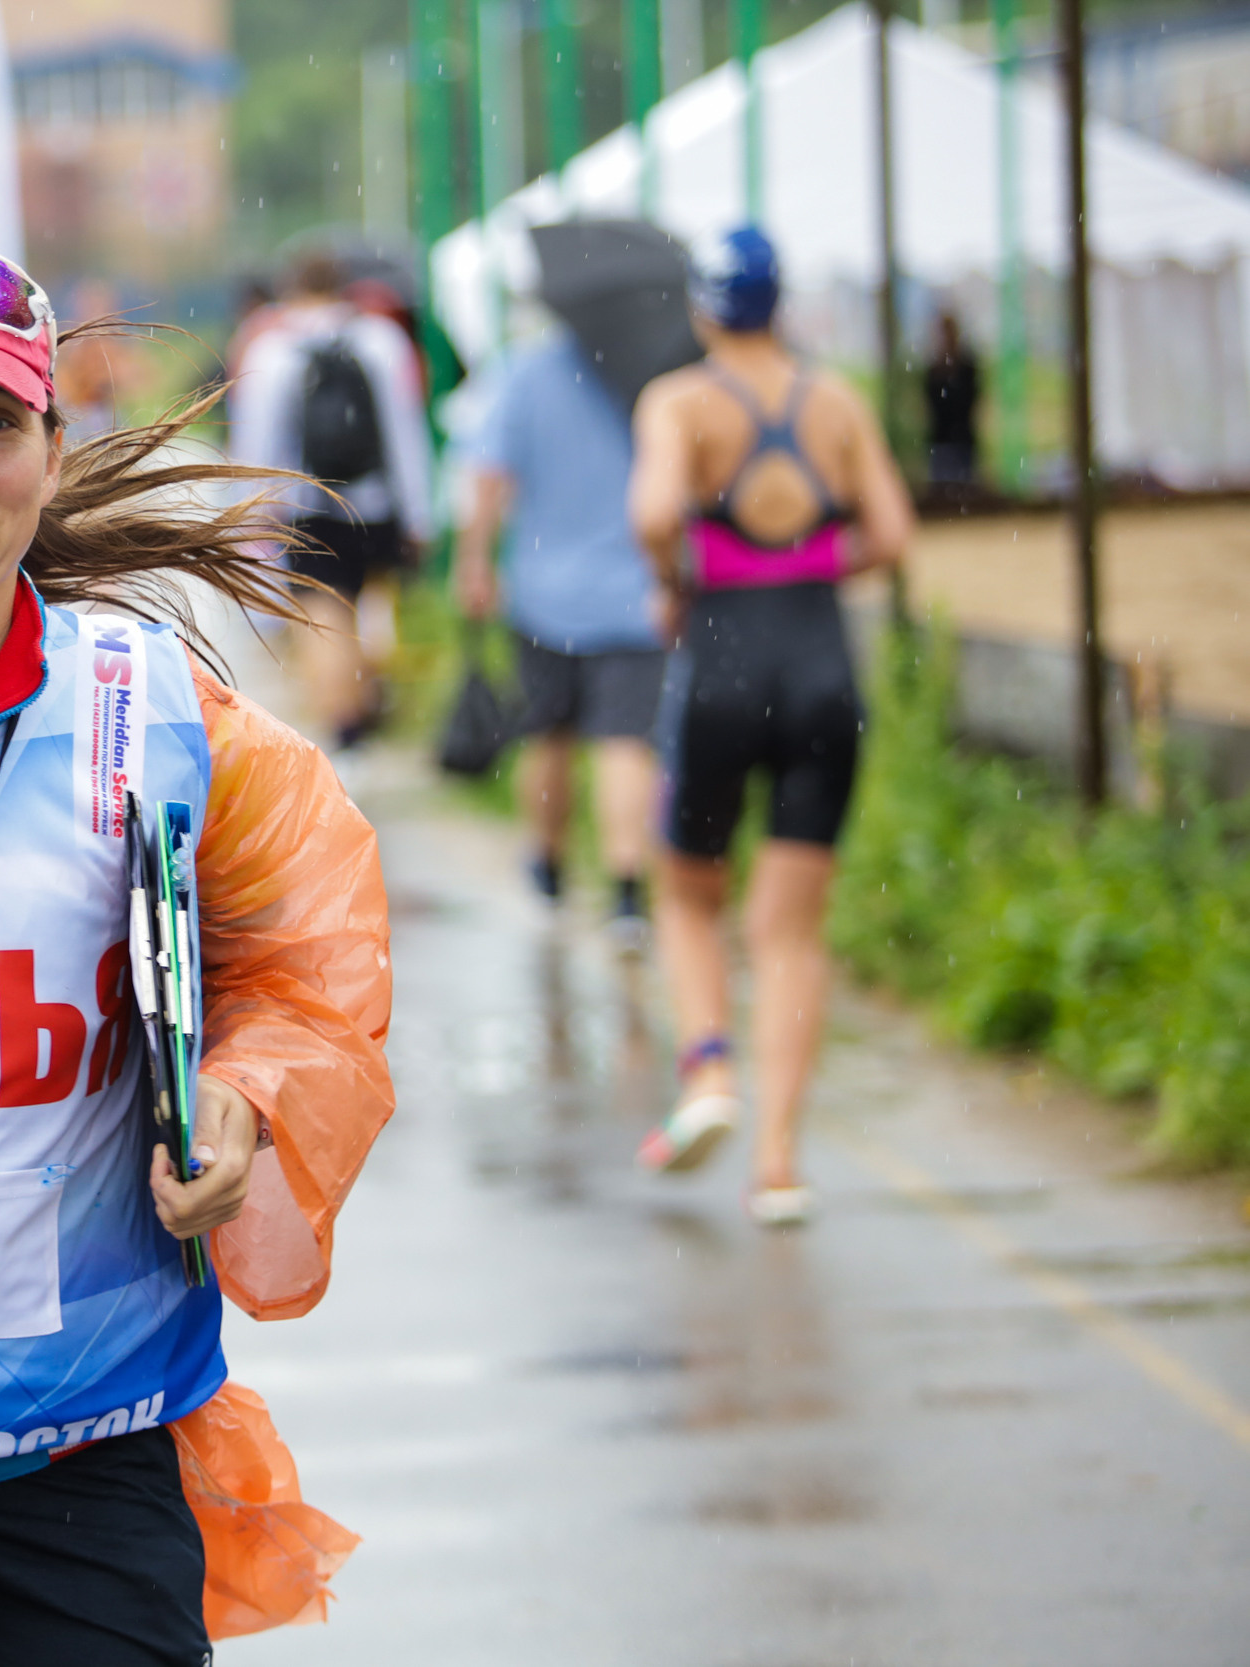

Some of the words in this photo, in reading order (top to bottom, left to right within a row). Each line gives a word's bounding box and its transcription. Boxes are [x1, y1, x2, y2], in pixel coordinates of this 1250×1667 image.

[102, 687, 110, 749] ГРУЗОПЕРЕВОЗКИ
[113, 689, 131, 768] Meridian
[101, 750, 108, 762] ПО
[113, 772, 127, 838] Service
